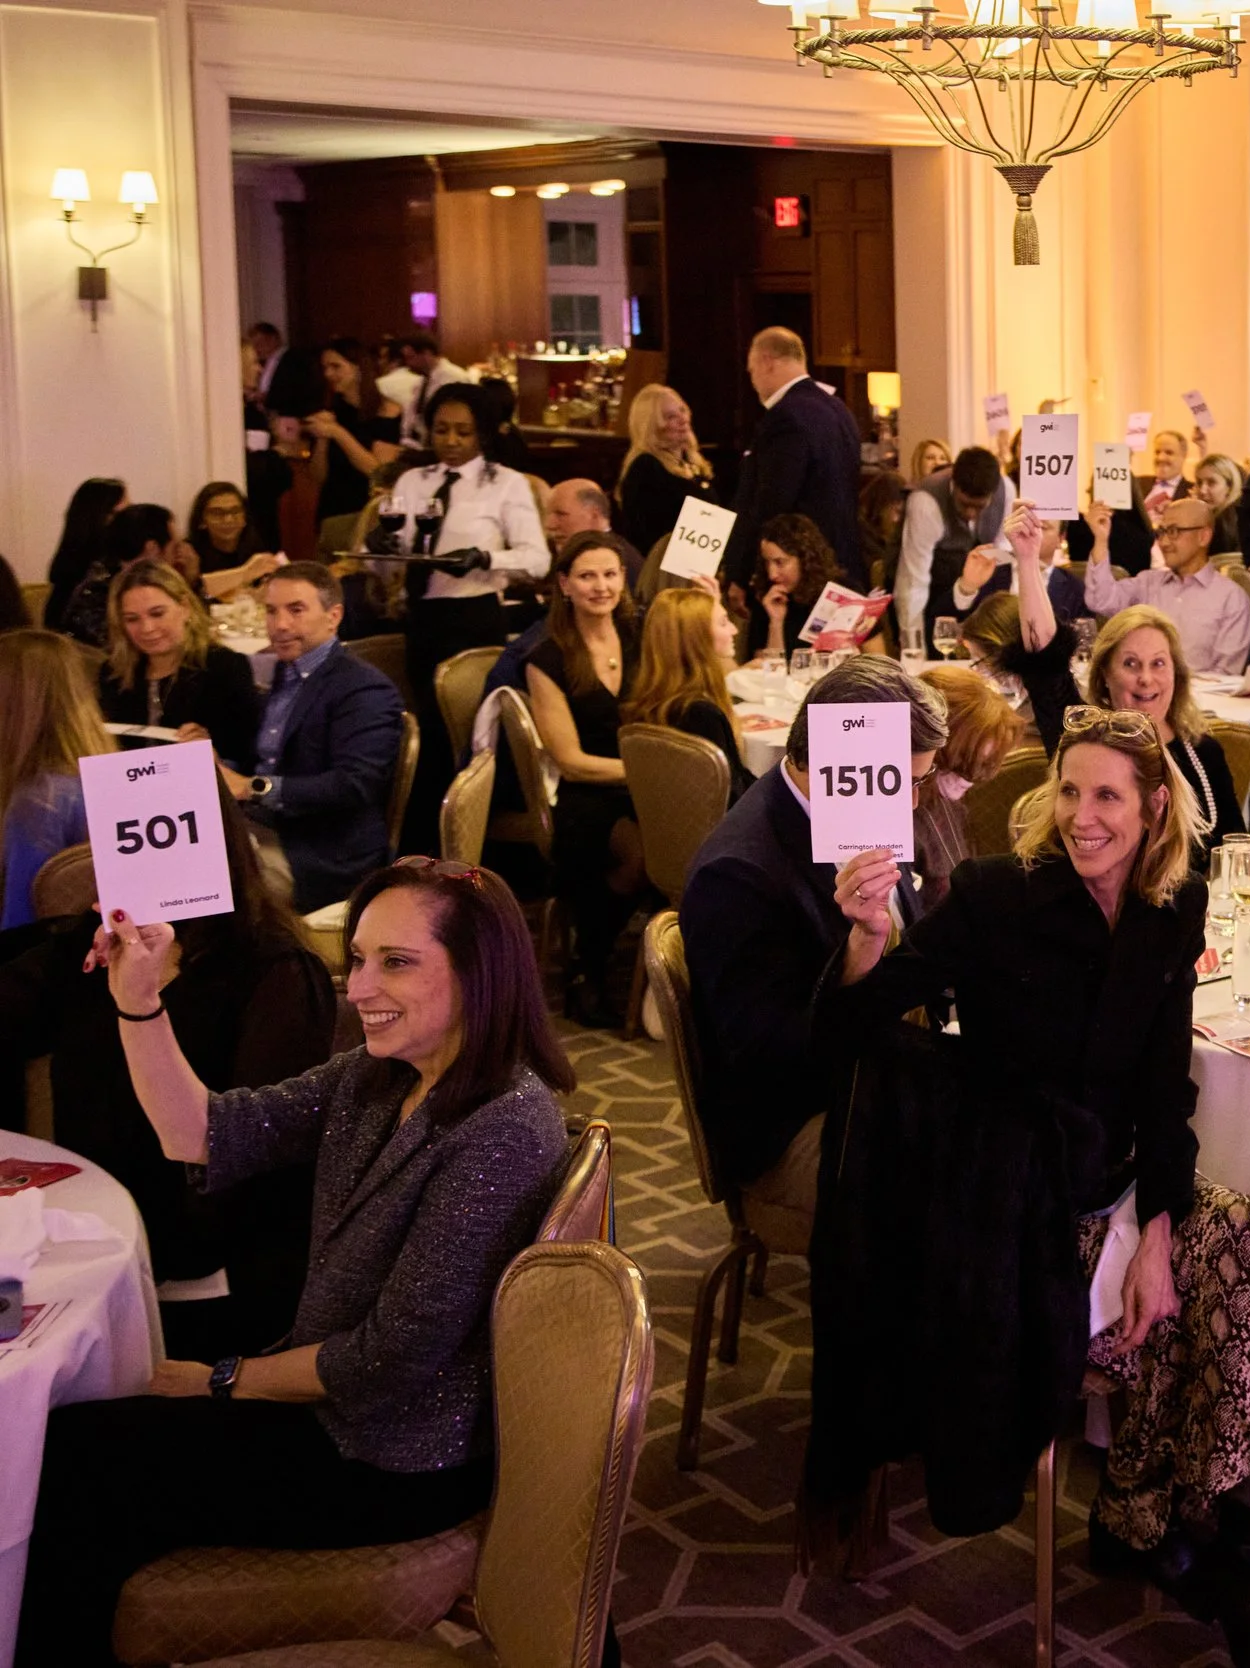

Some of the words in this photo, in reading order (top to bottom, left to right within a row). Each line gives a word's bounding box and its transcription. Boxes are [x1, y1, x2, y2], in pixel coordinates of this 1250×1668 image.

[1025, 454, 1074, 476] 1507
[1096, 467, 1127, 481] 1403
[678, 526, 722, 553] 1409
[842, 715, 865, 732] gwi
[126, 761, 156, 782] gwi
[818, 764, 902, 797] 1510
[116, 810, 200, 855] 501
[159, 899, 184, 908] Linda
[184, 893, 220, 904] Leonard
